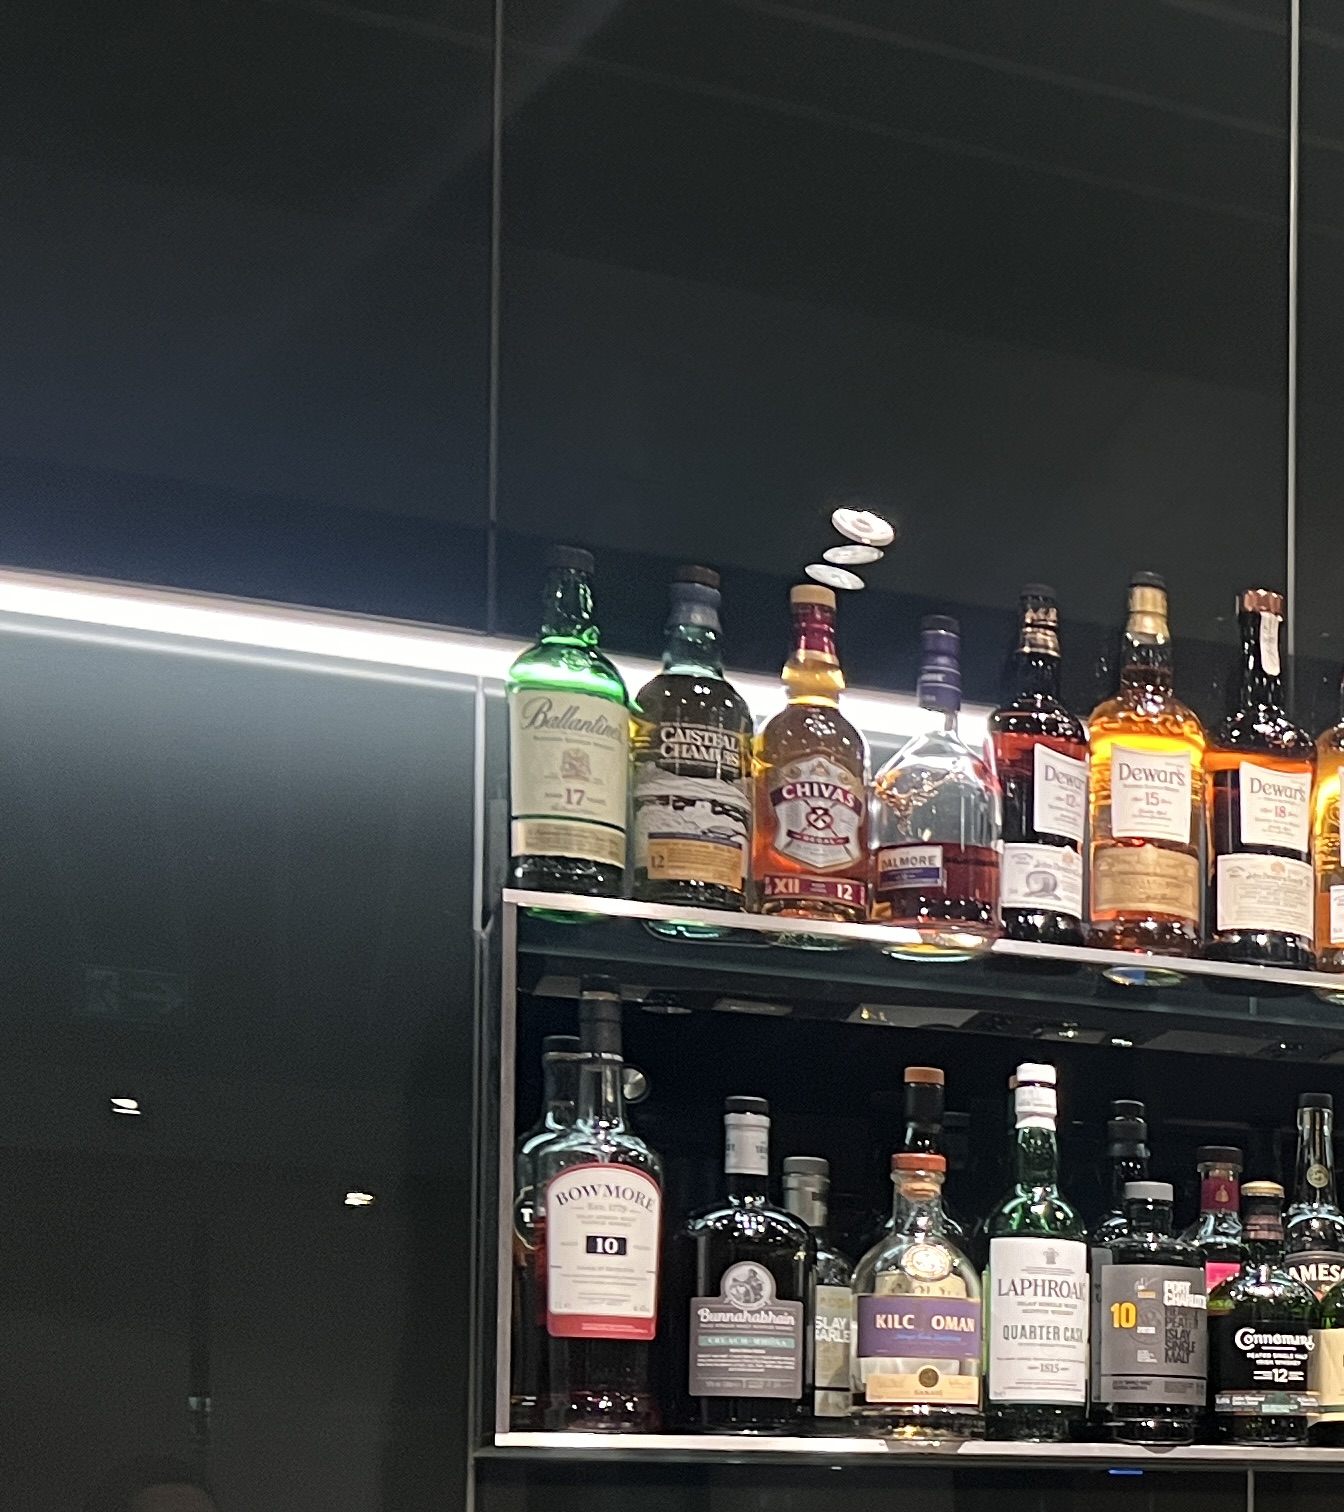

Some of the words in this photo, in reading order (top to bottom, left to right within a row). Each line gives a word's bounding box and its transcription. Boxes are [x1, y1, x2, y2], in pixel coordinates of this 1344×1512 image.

[1118, 762, 1186, 787] Dewar's
[565, 787, 585, 806] 17
[781, 782, 855, 808] CHIVAS
[1144, 791, 1160, 806] 15
[1274, 805, 1287, 818] 18
[836, 883, 853, 901] 12
[556, 1184, 656, 1214] BOWMORE
[594, 1238, 619, 1255] 10
[697, 1309, 797, 1327] Bunnahabhain
[1110, 1301, 1137, 1329] 10
[1003, 1325, 1061, 1342] QUARTER
[1271, 1368, 1289, 1383] 12
